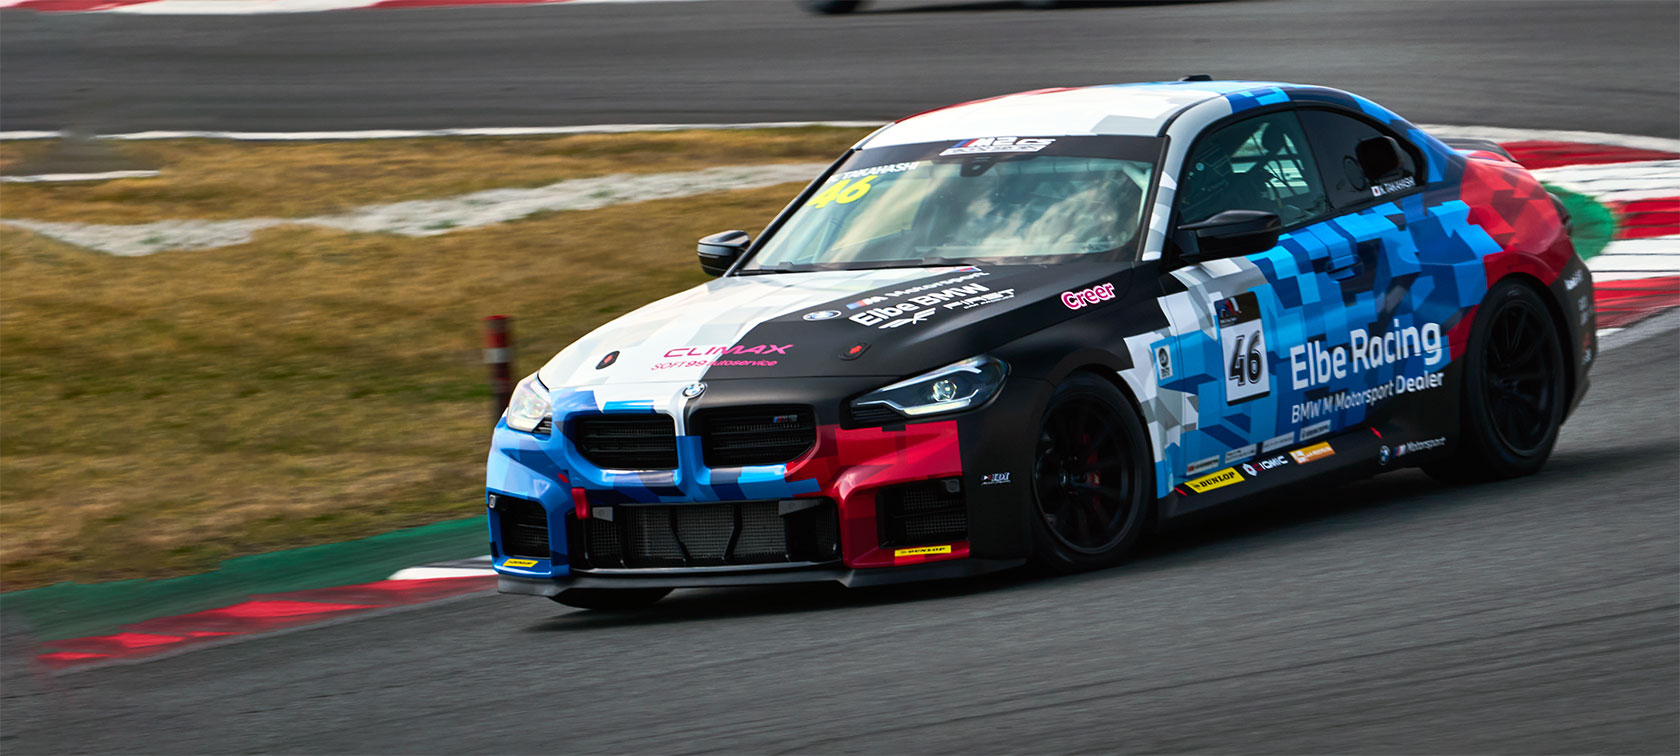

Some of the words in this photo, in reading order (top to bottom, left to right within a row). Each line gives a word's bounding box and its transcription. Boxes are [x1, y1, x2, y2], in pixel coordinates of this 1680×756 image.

[806, 174, 879, 209] 46
[849, 302, 920, 326] Elbe
[908, 283, 990, 306] BMW
[1060, 282, 1116, 310] Creer
[664, 344, 794, 358] CLIMAX
[1229, 330, 1262, 387] 46
[1290, 340, 1347, 390] Elbe
[1350, 318, 1442, 373] Racing
[1291, 398, 1323, 424] BMW
[1322, 395, 1334, 415] M
[1334, 379, 1394, 411] Motorsport
[1395, 370, 1445, 395] Dealer
[1199, 471, 1236, 488] DUNLOP
